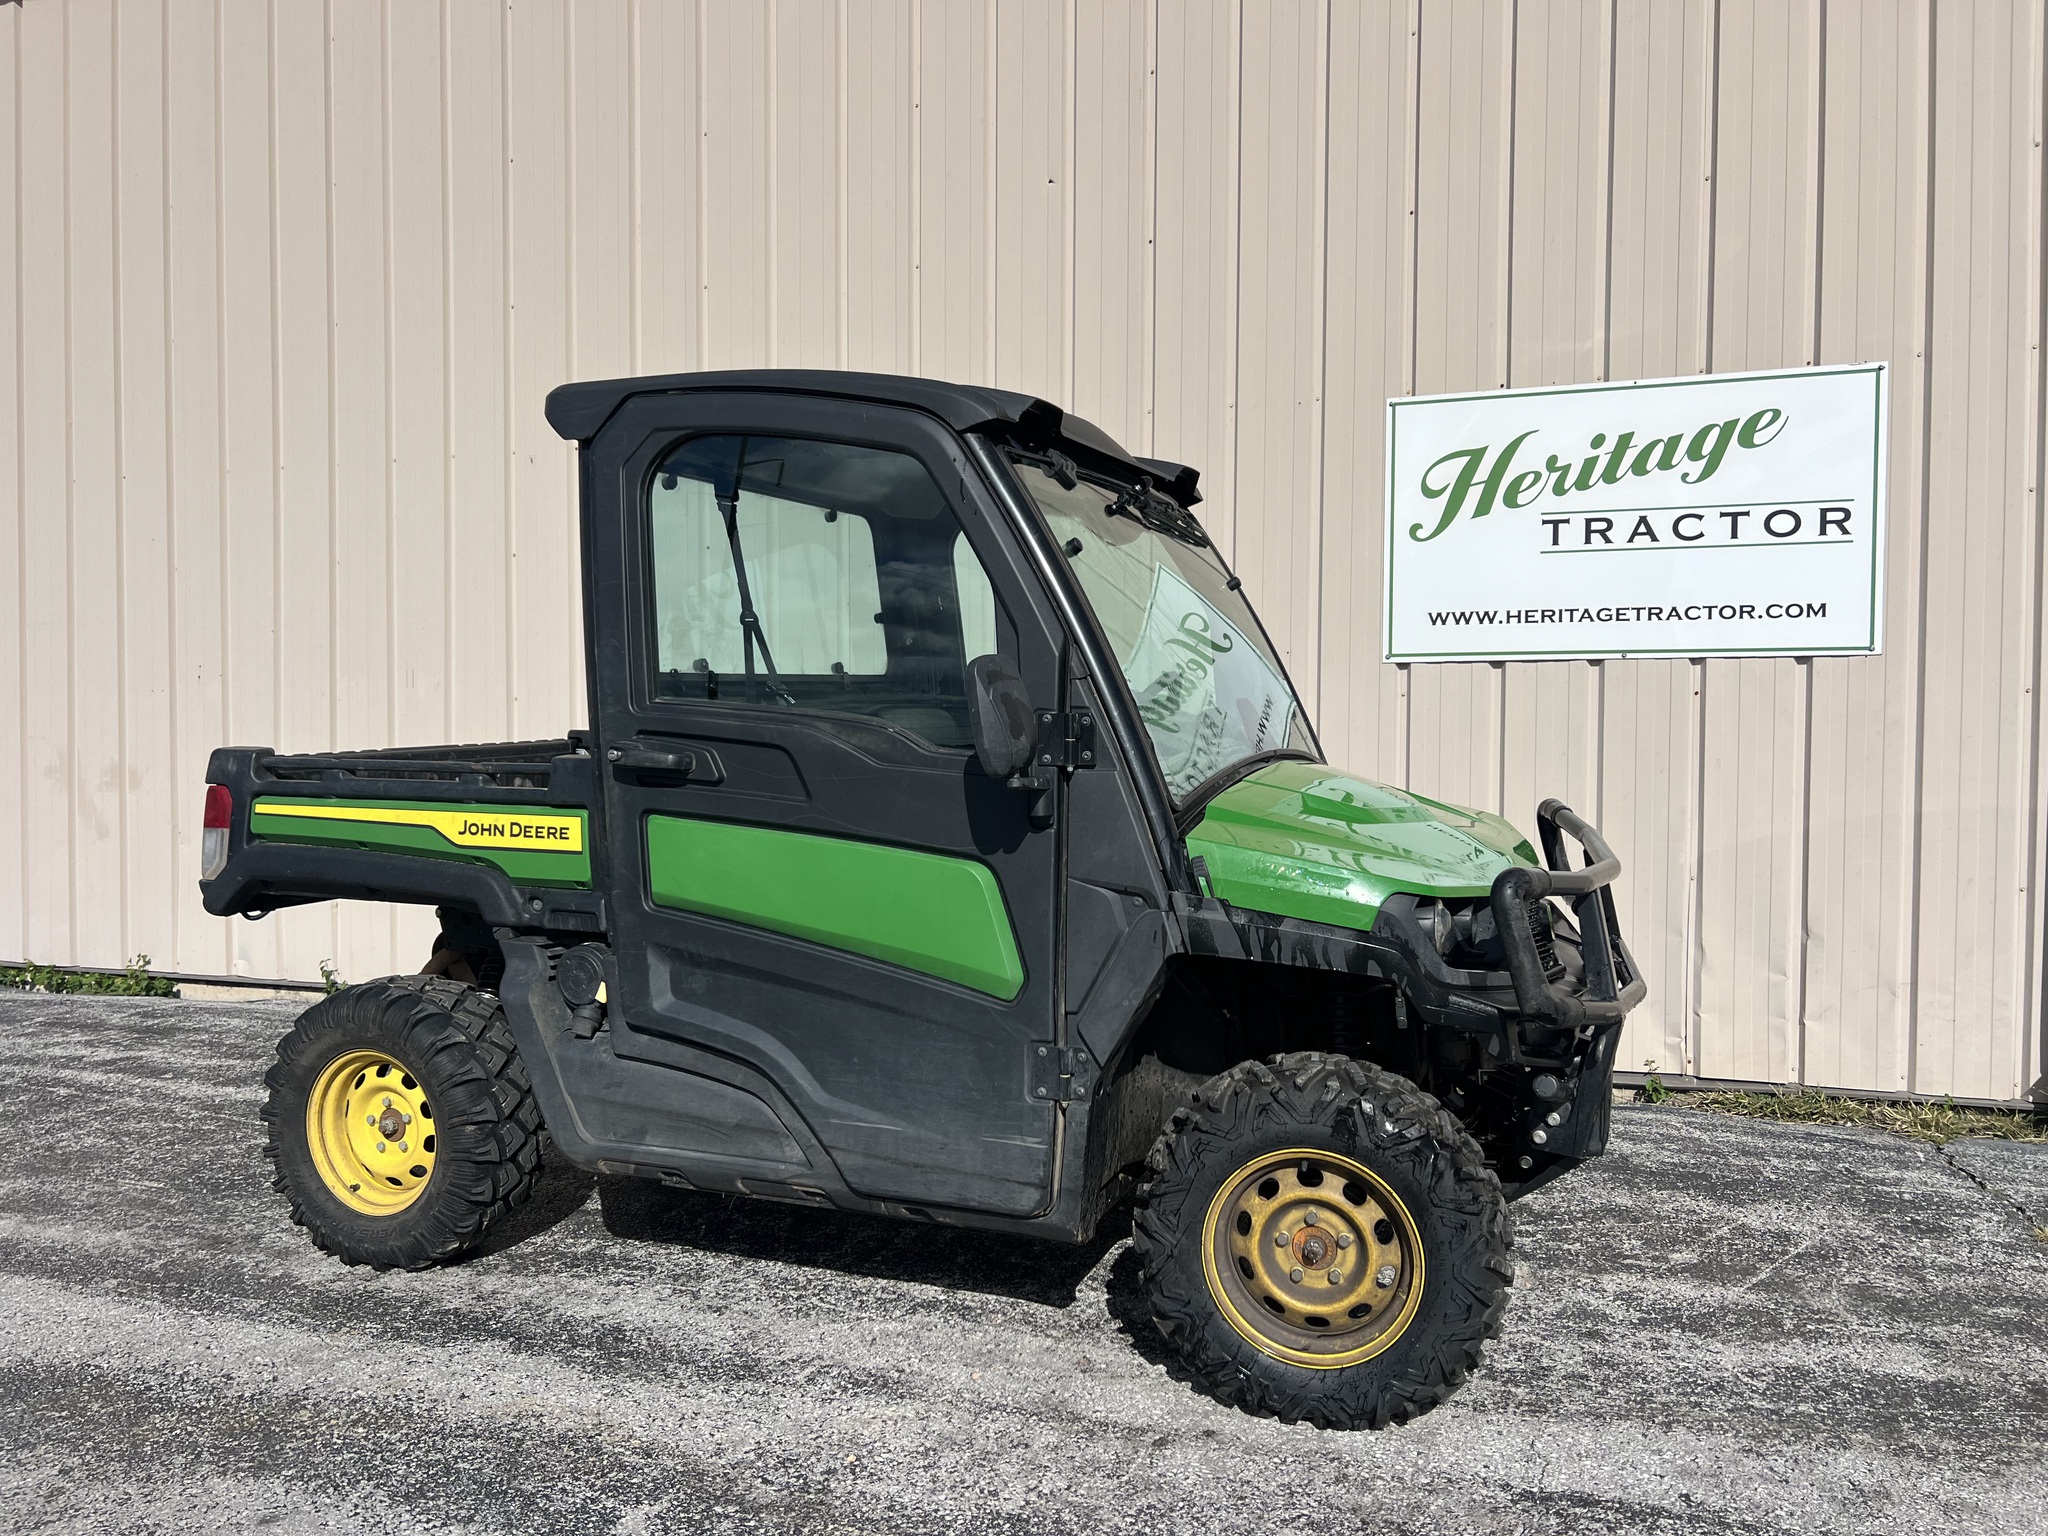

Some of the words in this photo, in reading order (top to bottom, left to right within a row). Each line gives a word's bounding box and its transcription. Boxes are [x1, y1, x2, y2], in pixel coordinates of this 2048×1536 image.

[1409, 408, 1789, 543] Heritage
[1541, 506, 1853, 547] TRACTOR
[1427, 602, 1828, 627] WWW.HERITAGETRACTOR.COM
[458, 819, 505, 838] JOHN
[509, 821, 570, 840] DEERE
